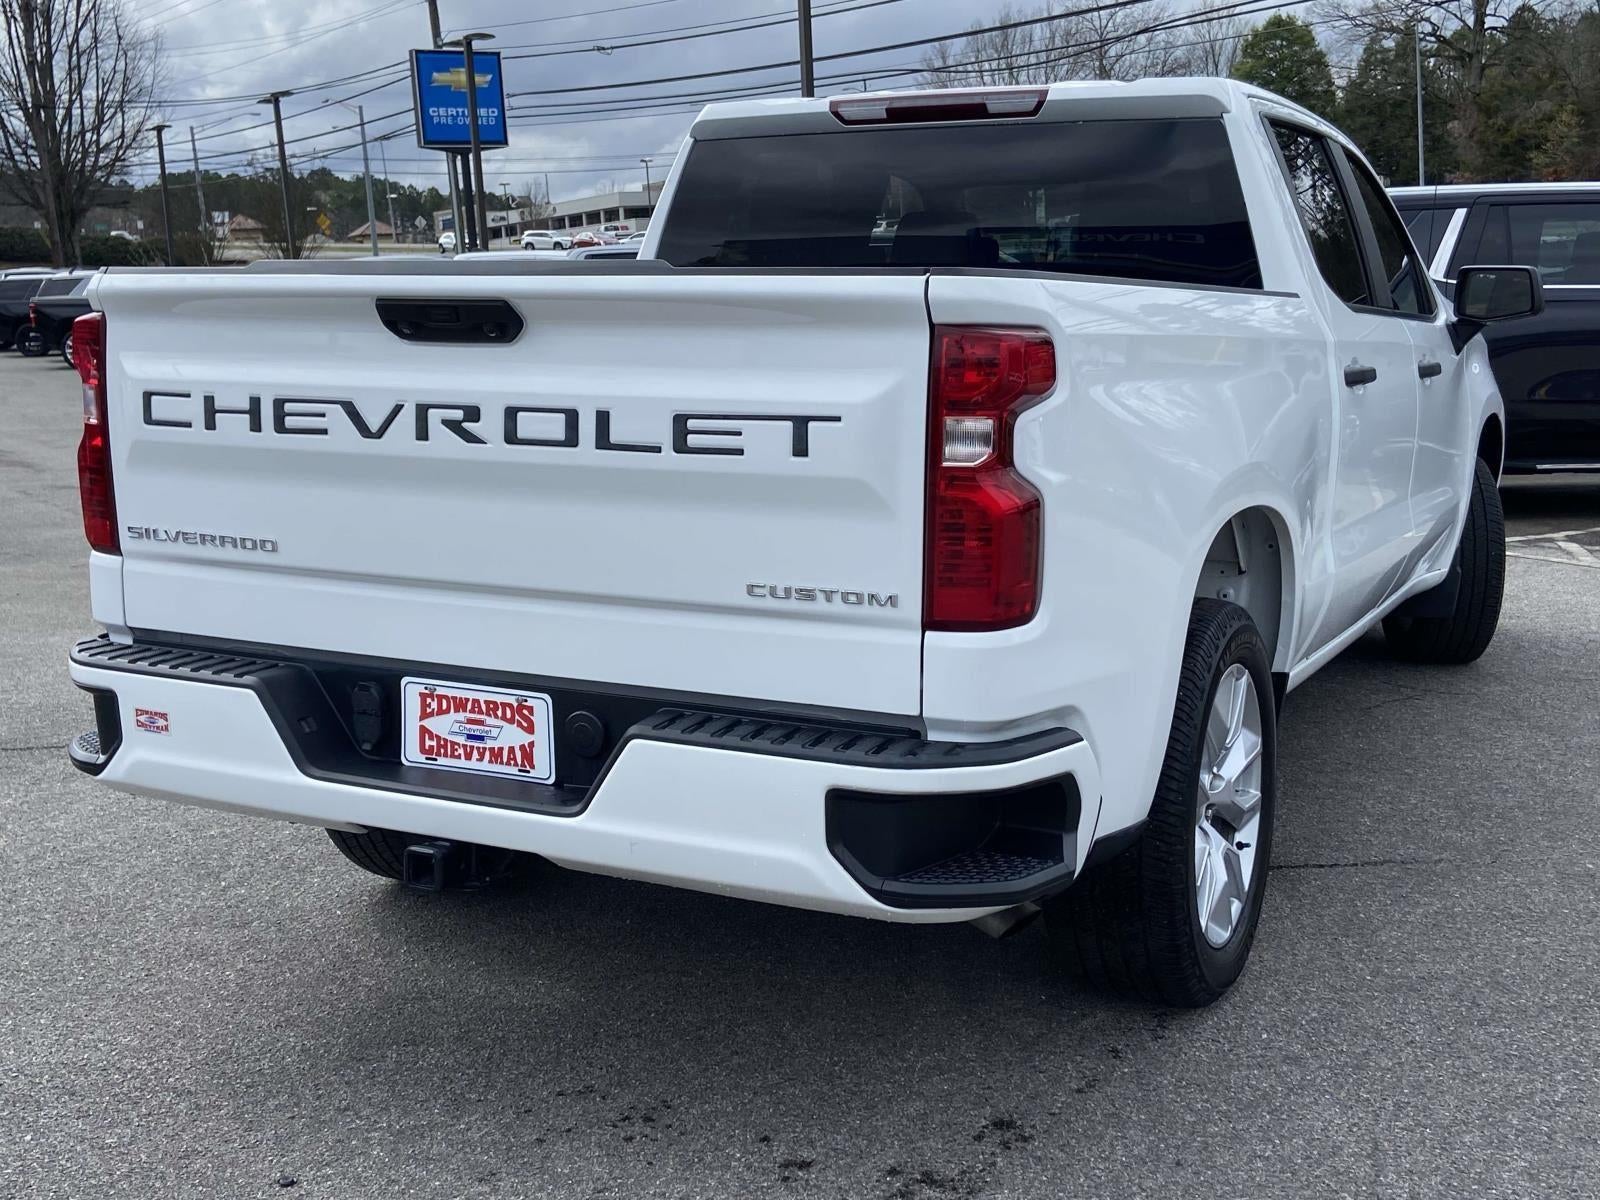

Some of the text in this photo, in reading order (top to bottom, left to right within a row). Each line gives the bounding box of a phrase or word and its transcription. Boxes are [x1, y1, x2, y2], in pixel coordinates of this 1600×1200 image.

[429, 107, 498, 117] CERTIIED
[143, 391, 842, 458] CHEVROLET
[127, 526, 279, 552] SILVERADO
[746, 583, 899, 608] CUSTOM
[418, 691, 535, 735] EDWARDS
[458, 724, 492, 735] Chevrolet
[418, 724, 535, 769] CHEVYMAN
